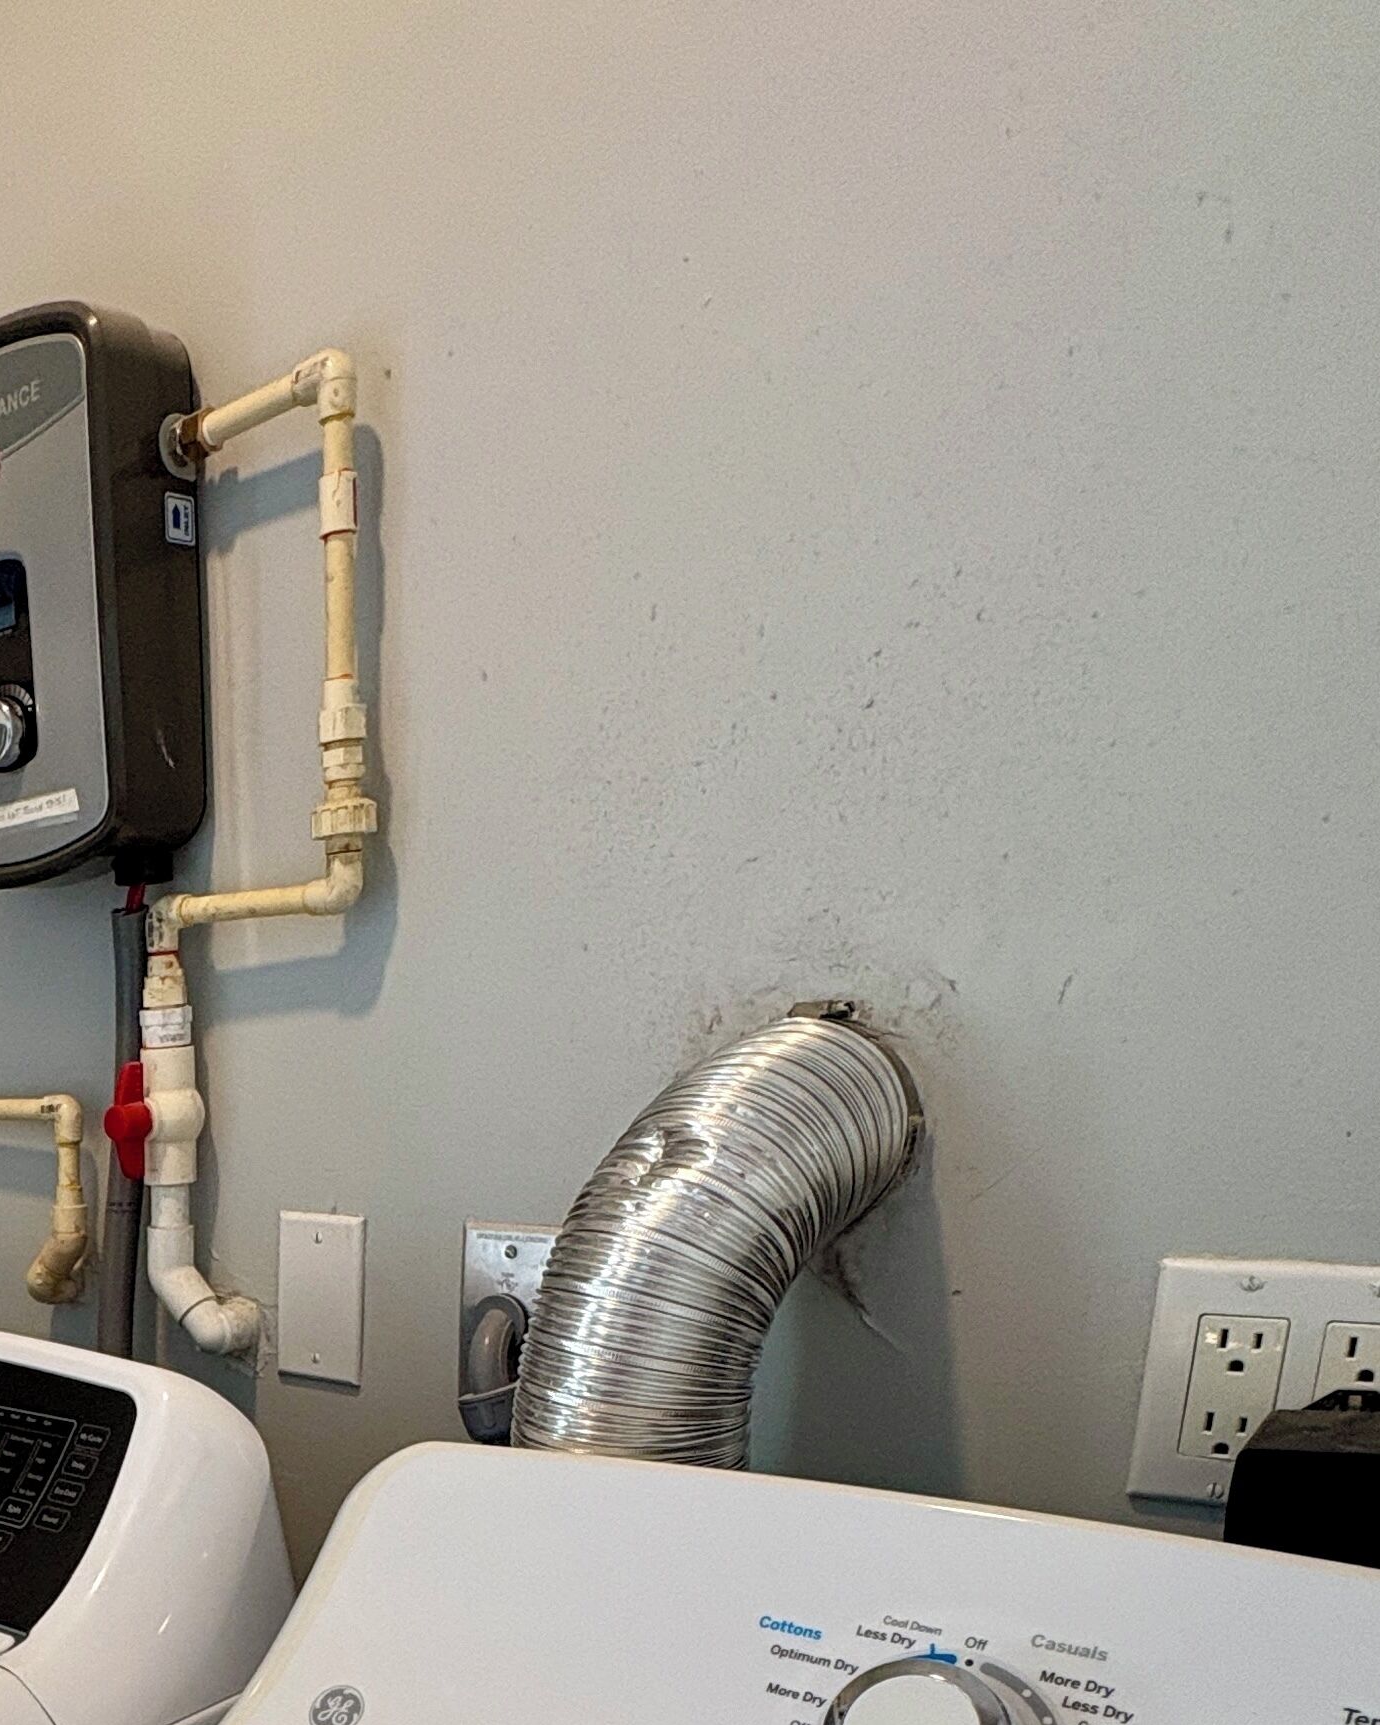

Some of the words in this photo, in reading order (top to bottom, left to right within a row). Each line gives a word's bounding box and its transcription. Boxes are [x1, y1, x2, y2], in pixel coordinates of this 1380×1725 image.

[759, 1616, 823, 1641] Cottons
[856, 1625, 888, 1642] Less
[890, 1632, 917, 1649] Dry
[883, 1615, 909, 1630] Cool
[909, 1621, 943, 1636] Down
[964, 1636, 989, 1651] Off
[1031, 1634, 1109, 1662] Casuals
[770, 1644, 832, 1668] Optimum
[833, 1658, 860, 1676] Dry
[766, 1682, 800, 1699] More
[802, 1691, 828, 1708] Dry
[1039, 1670, 1081, 1689] More
[1084, 1680, 1116, 1698] Dry
[1061, 1696, 1099, 1715] Less
[1102, 1705, 1135, 1724] Dry
